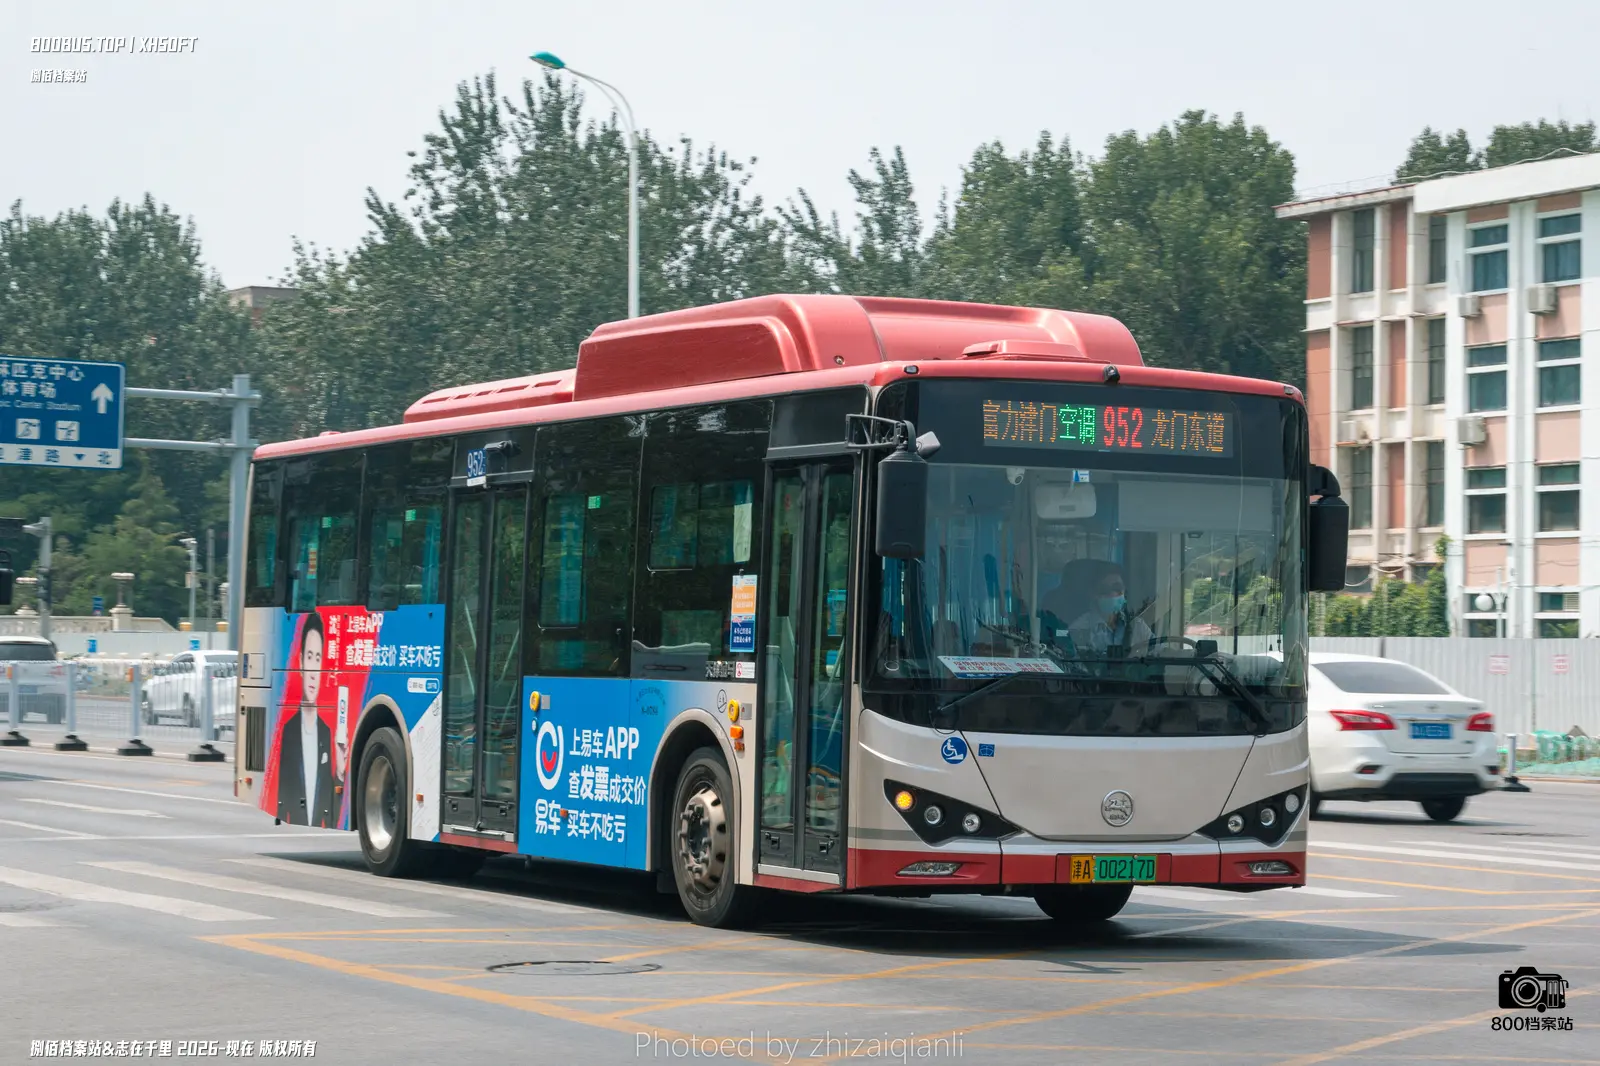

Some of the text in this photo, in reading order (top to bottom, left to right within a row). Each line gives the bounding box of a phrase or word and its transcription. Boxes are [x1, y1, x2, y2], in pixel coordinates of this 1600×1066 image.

[1057, 404, 1096, 444] 空调
[1103, 406, 1143, 448] 952
[1151, 409, 1225, 452] 龙门东道
[467, 451, 484, 478] 952
[345, 639, 397, 666] 查发票成交价
[399, 645, 441, 668] 买车不吃亏
[569, 726, 640, 760] 上易车APP
[568, 764, 647, 806] 查发票成交价
[535, 799, 626, 843] 易车 买车不吃亏
